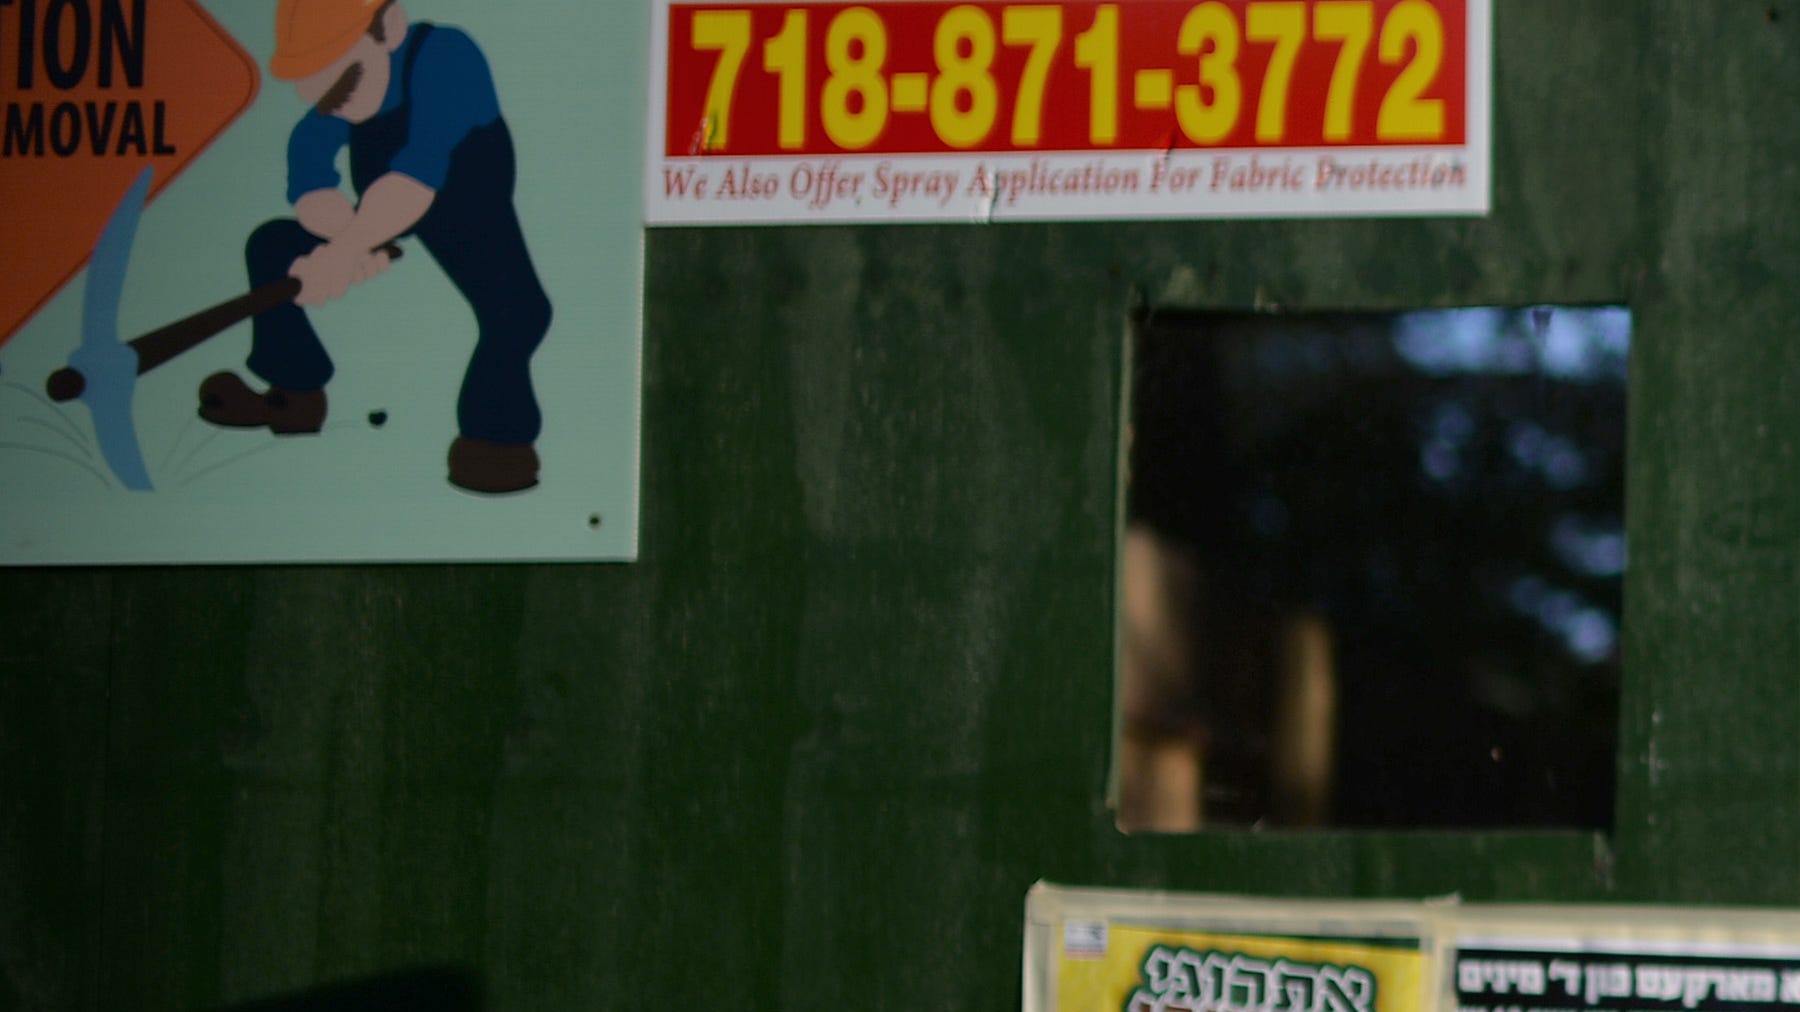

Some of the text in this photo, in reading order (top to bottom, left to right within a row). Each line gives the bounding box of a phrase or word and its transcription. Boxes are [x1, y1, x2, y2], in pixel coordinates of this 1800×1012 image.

[0, 0, 147, 89] ION
[690, 2, 1445, 150] 718-871-3772
[3, 101, 176, 157] MOVAL
[663, 152, 1467, 210] We Also Offer Spray Application For Fabric Protection
[1458, 959, 1545, 996] מינים
